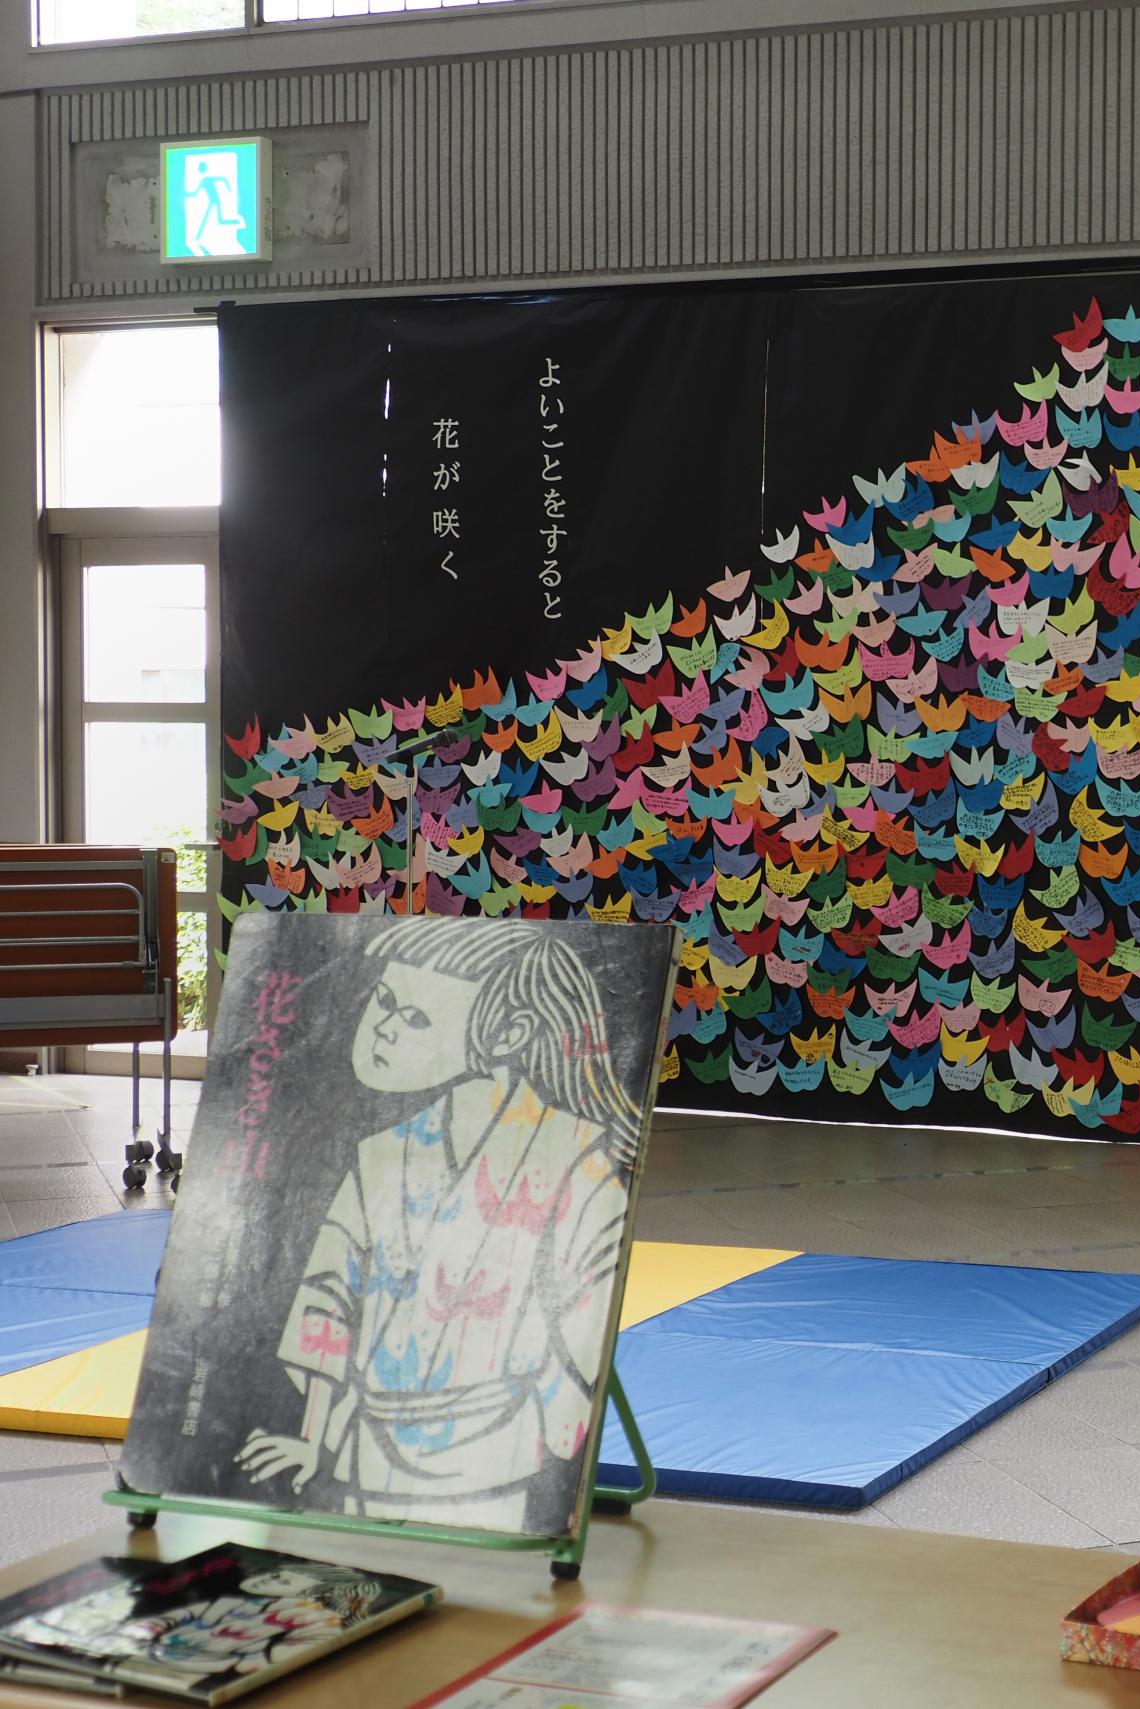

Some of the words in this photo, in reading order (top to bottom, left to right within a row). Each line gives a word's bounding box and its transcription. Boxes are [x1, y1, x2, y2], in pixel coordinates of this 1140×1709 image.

[432, 418, 461, 580] 花が咲く
[538, 357, 567, 619] よいことをすると
[220, 970, 302, 1179] 花さき山
